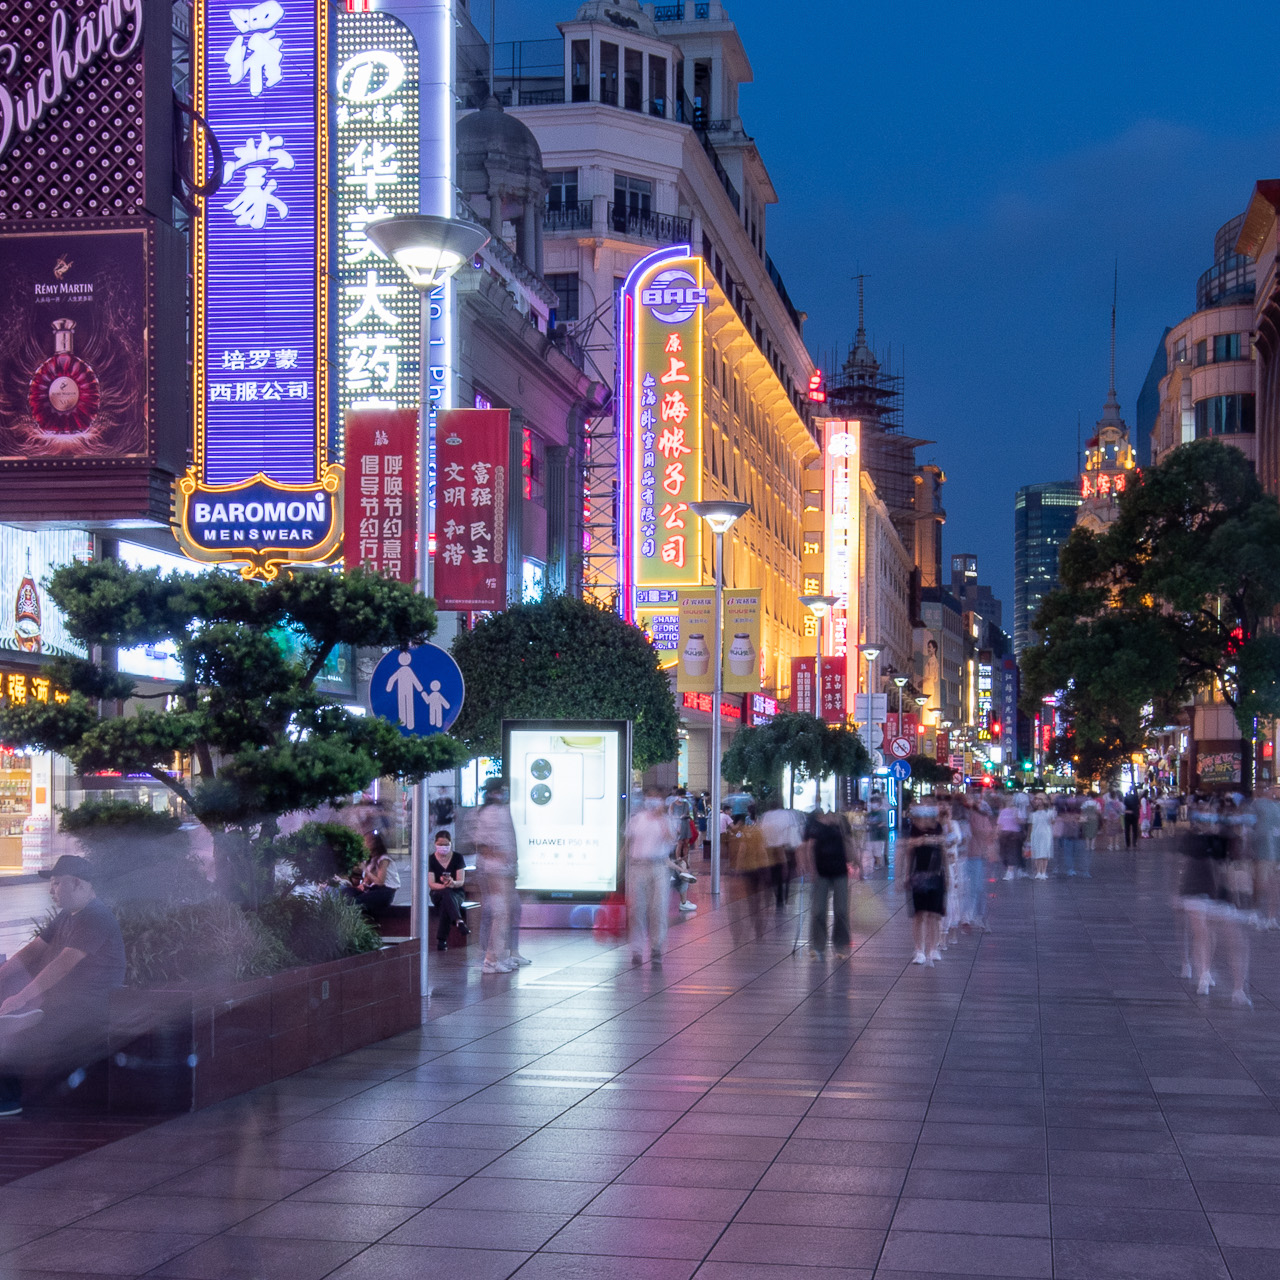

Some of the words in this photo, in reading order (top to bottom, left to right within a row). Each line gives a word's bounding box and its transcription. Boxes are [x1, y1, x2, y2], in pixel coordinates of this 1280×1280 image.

[344, 140, 401, 409] 华美大药
[34, 282, 59, 295] RÉMY
[59, 283, 94, 294] MARTIN
[642, 288, 707, 305] BAC
[221, 348, 299, 371] 培罗蒙
[210, 381, 309, 402] 西服公司
[443, 462, 466, 507] 文明
[471, 461, 493, 507] 富强
[195, 501, 326, 524] BAROMON
[203, 528, 314, 542] MENSWEAR
[442, 519, 465, 566] 和谐
[470, 520, 491, 564] 民主
[825, 675, 832, 690] 公正
[834, 674, 842, 690] 自由
[834, 693, 842, 710] 平等
[528, 838, 566, 846] HUAWEI
